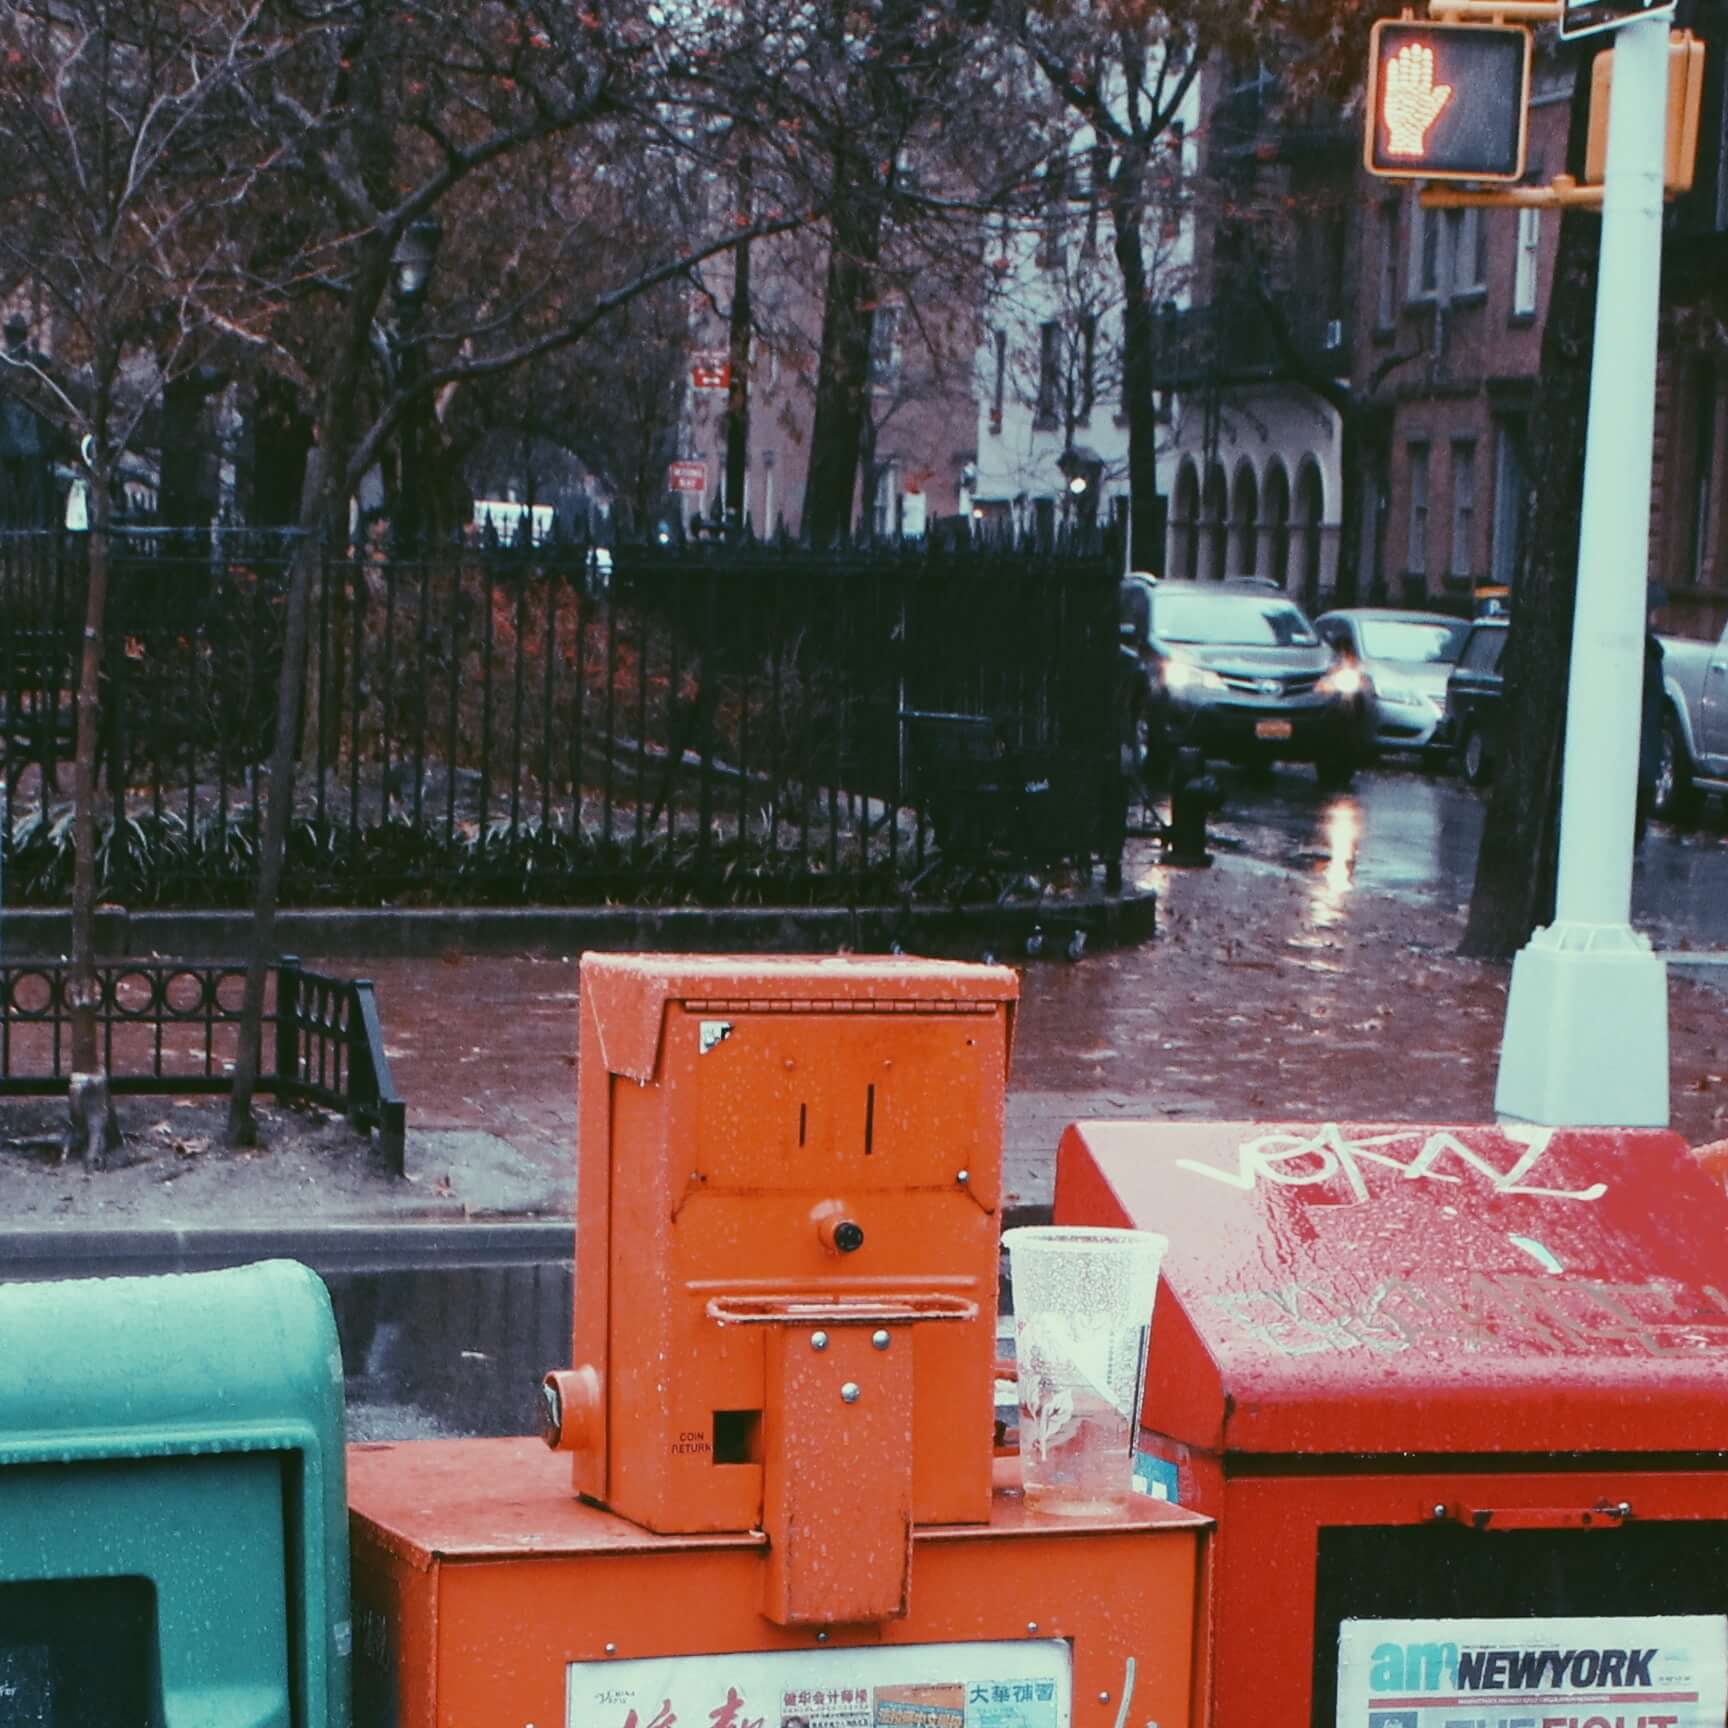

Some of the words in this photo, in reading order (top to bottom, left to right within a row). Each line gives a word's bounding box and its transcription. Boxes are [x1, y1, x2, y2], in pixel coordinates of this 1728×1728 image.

[679, 1431, 704, 1442] COIN
[671, 1443, 712, 1454] RETURN
[1457, 1648, 1659, 1691] NEWYORK
[0, 1683, 17, 1698] For
